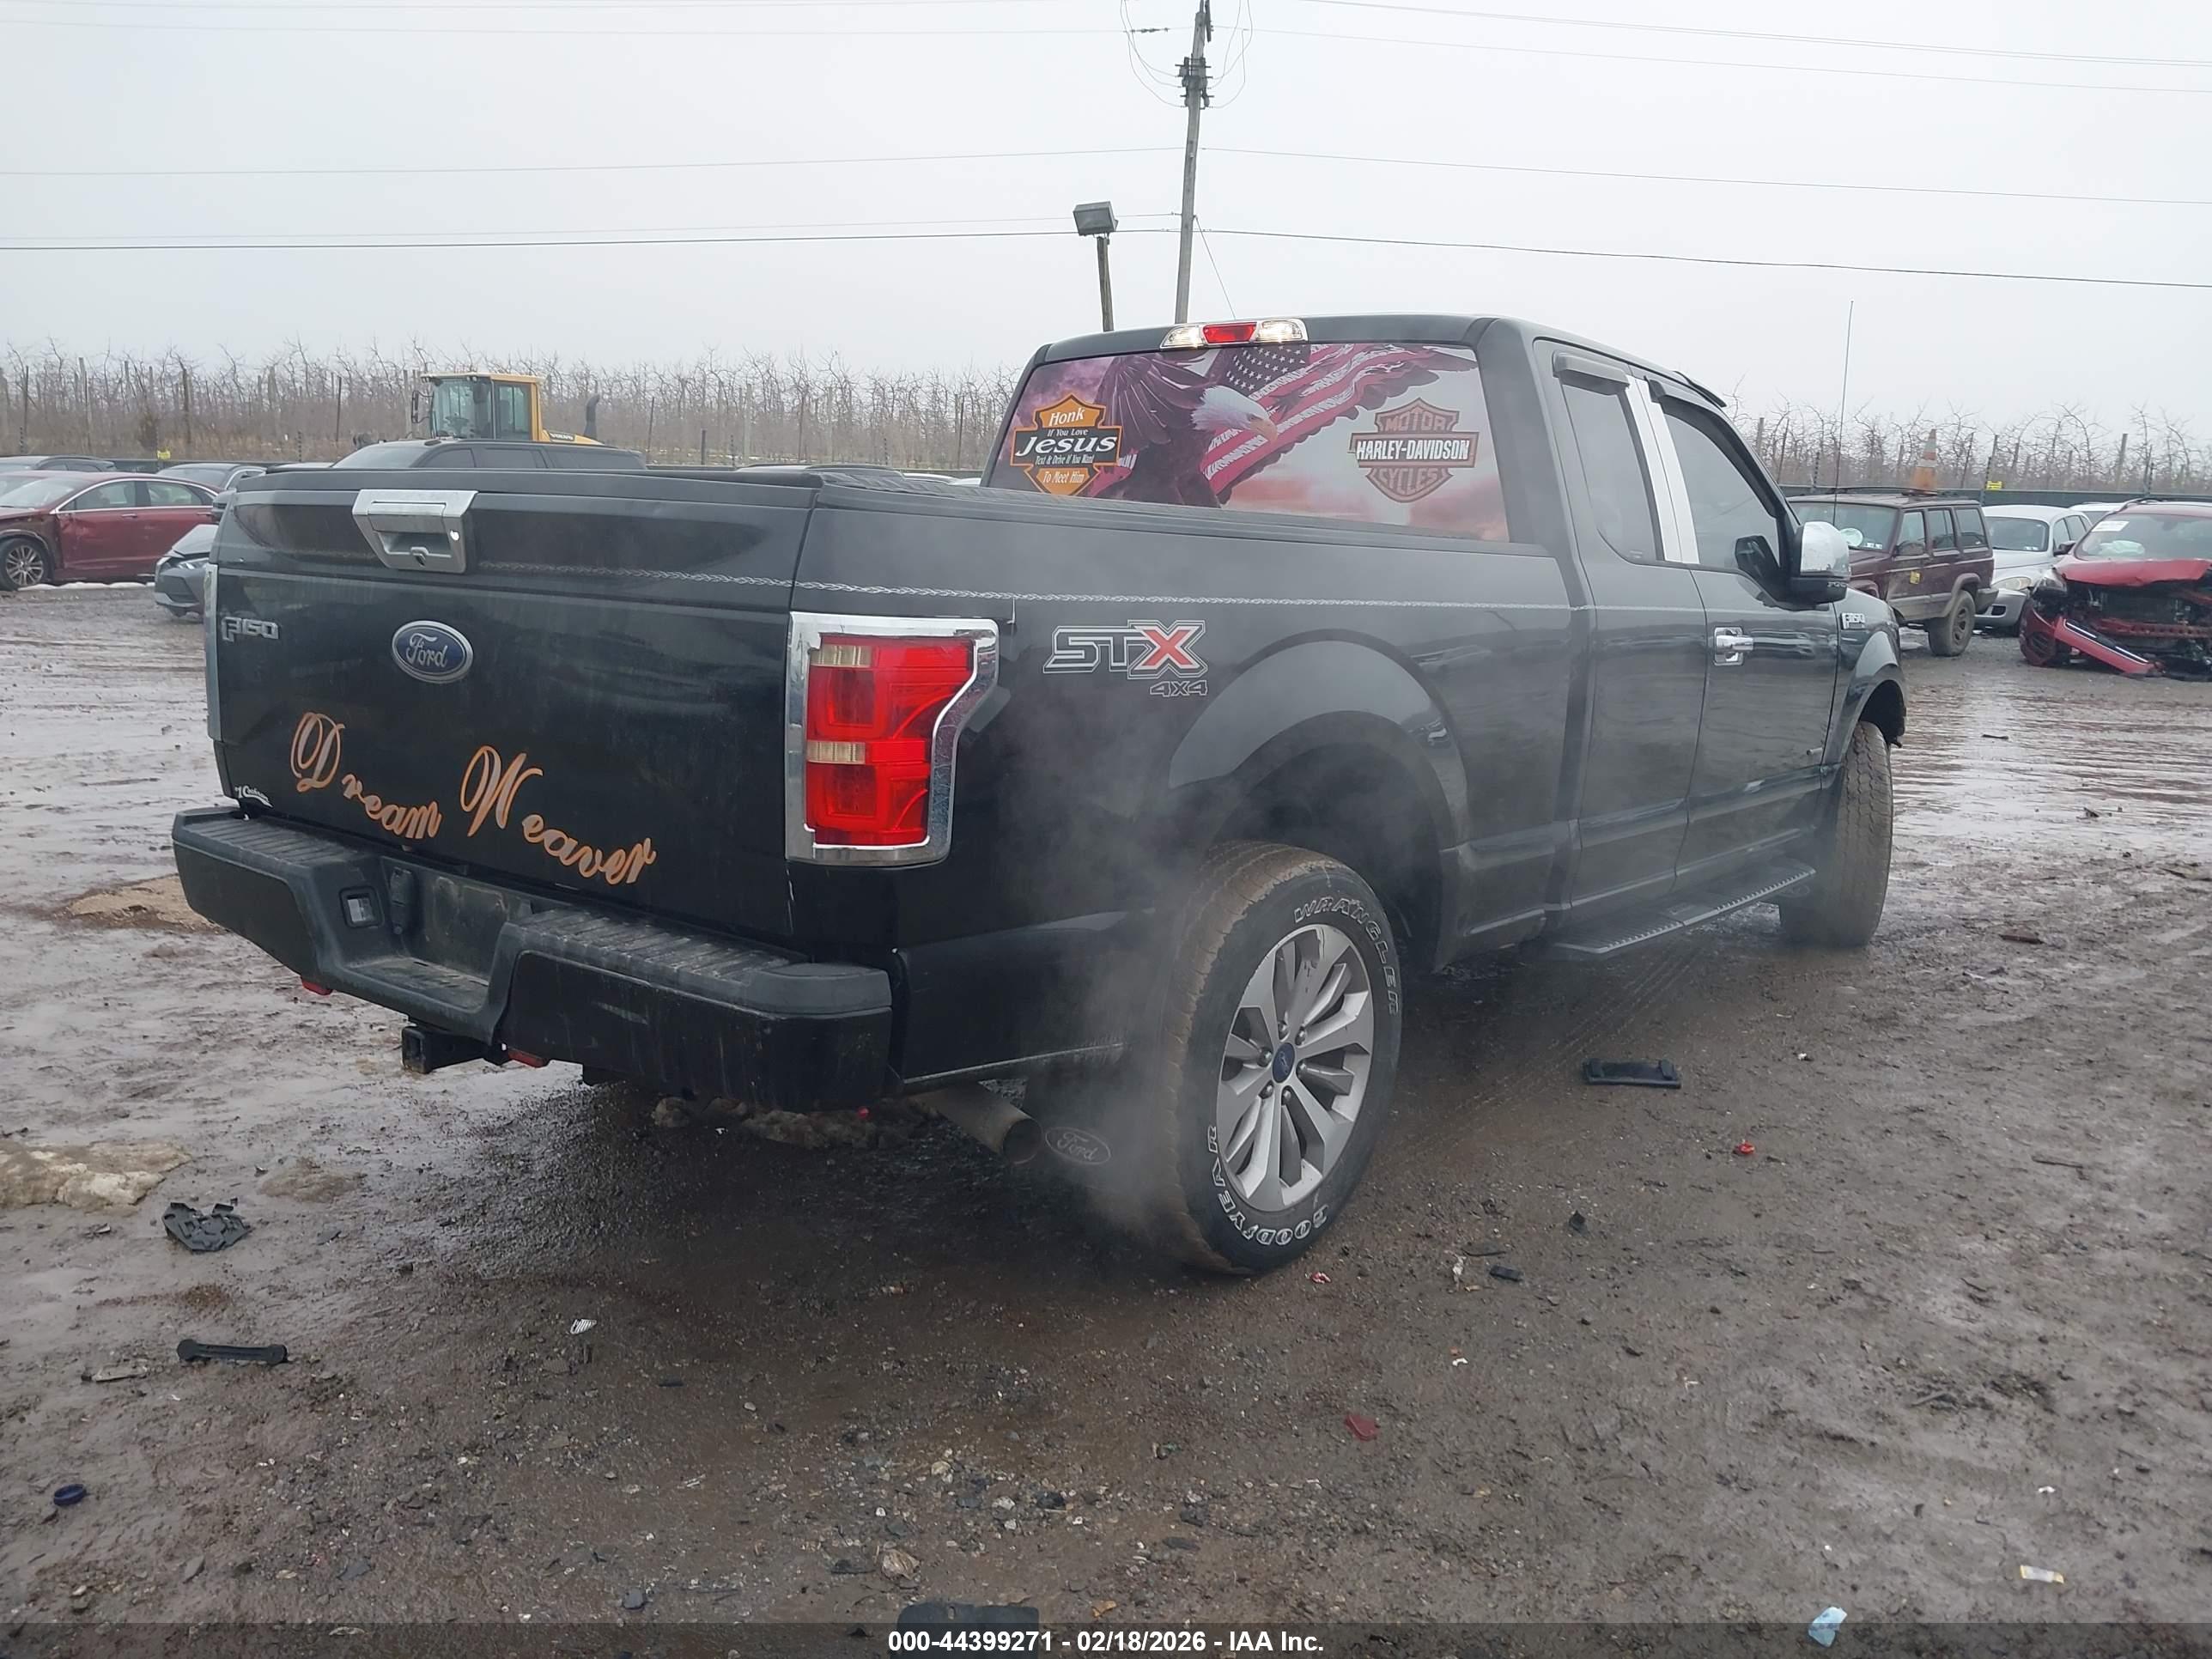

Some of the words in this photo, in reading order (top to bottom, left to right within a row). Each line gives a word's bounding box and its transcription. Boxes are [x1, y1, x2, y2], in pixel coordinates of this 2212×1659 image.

[1048, 407, 1085, 427] Honk
[1384, 407, 1446, 431] MOTOR
[1015, 436, 1118, 457] Jesus
[1357, 440, 1470, 460] HARLEY-DAVIDSON
[1043, 471, 1052, 483] To
[1052, 471, 1069, 483] Meet
[1070, 471, 1085, 483] Him
[1377, 467, 1439, 495] CYCLES
[405, 632, 448, 667] Ford
[1043, 620, 1208, 679] STX
[290, 712, 444, 839] Dream
[459, 745, 657, 885] Weaver
[1294, 896, 1399, 1016] WRANGLER
[1057, 1132, 1098, 1161] Ford
[1207, 1125, 1328, 1245] GOODYEAR
